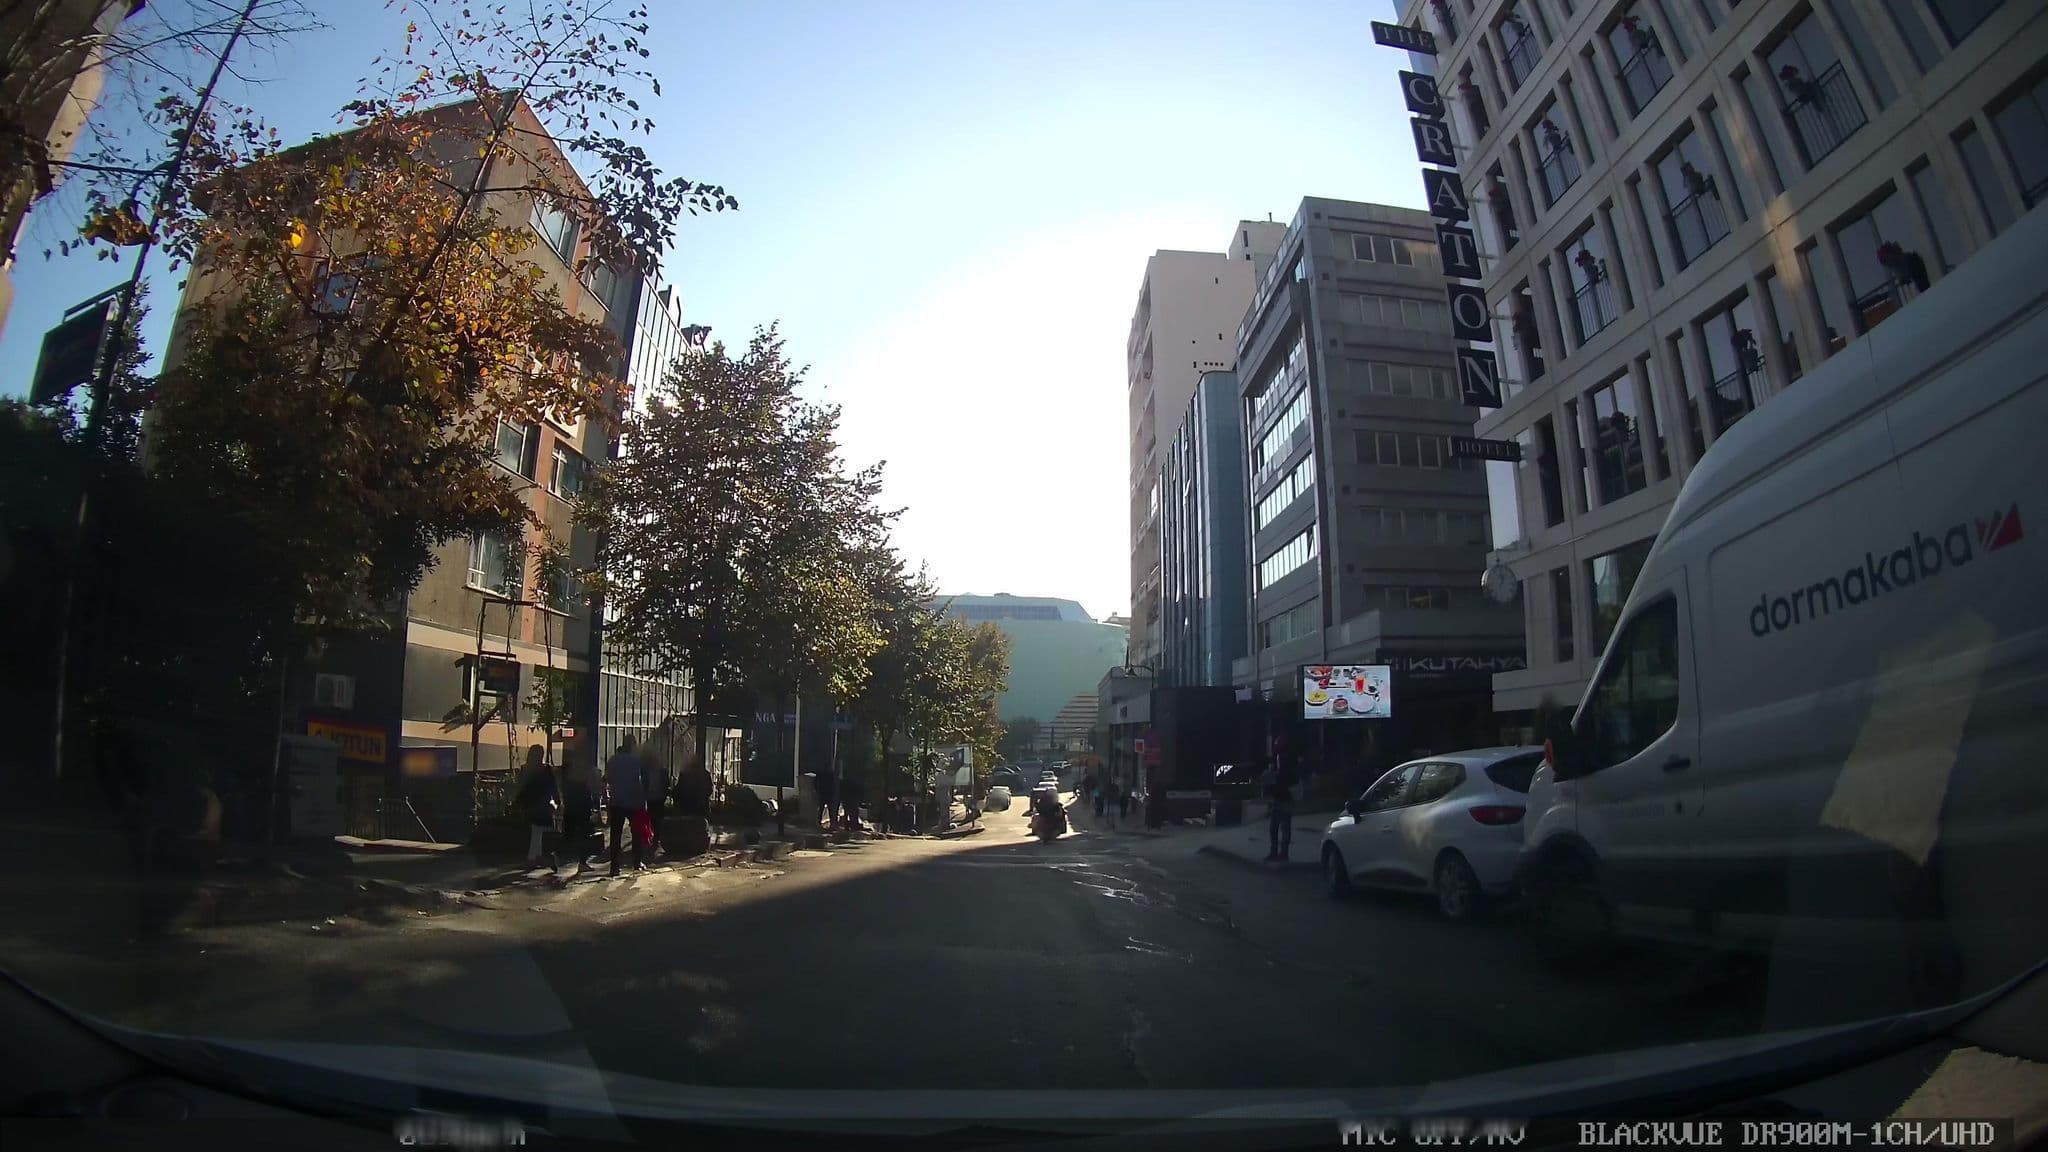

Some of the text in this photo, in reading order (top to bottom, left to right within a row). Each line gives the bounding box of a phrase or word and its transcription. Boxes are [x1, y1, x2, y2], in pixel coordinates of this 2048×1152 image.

[1377, 24, 1433, 49] THE
[1409, 76, 1498, 397] CRATON
[1458, 439, 1515, 457] HOTEL
[1750, 522, 1973, 637] dormakaba
